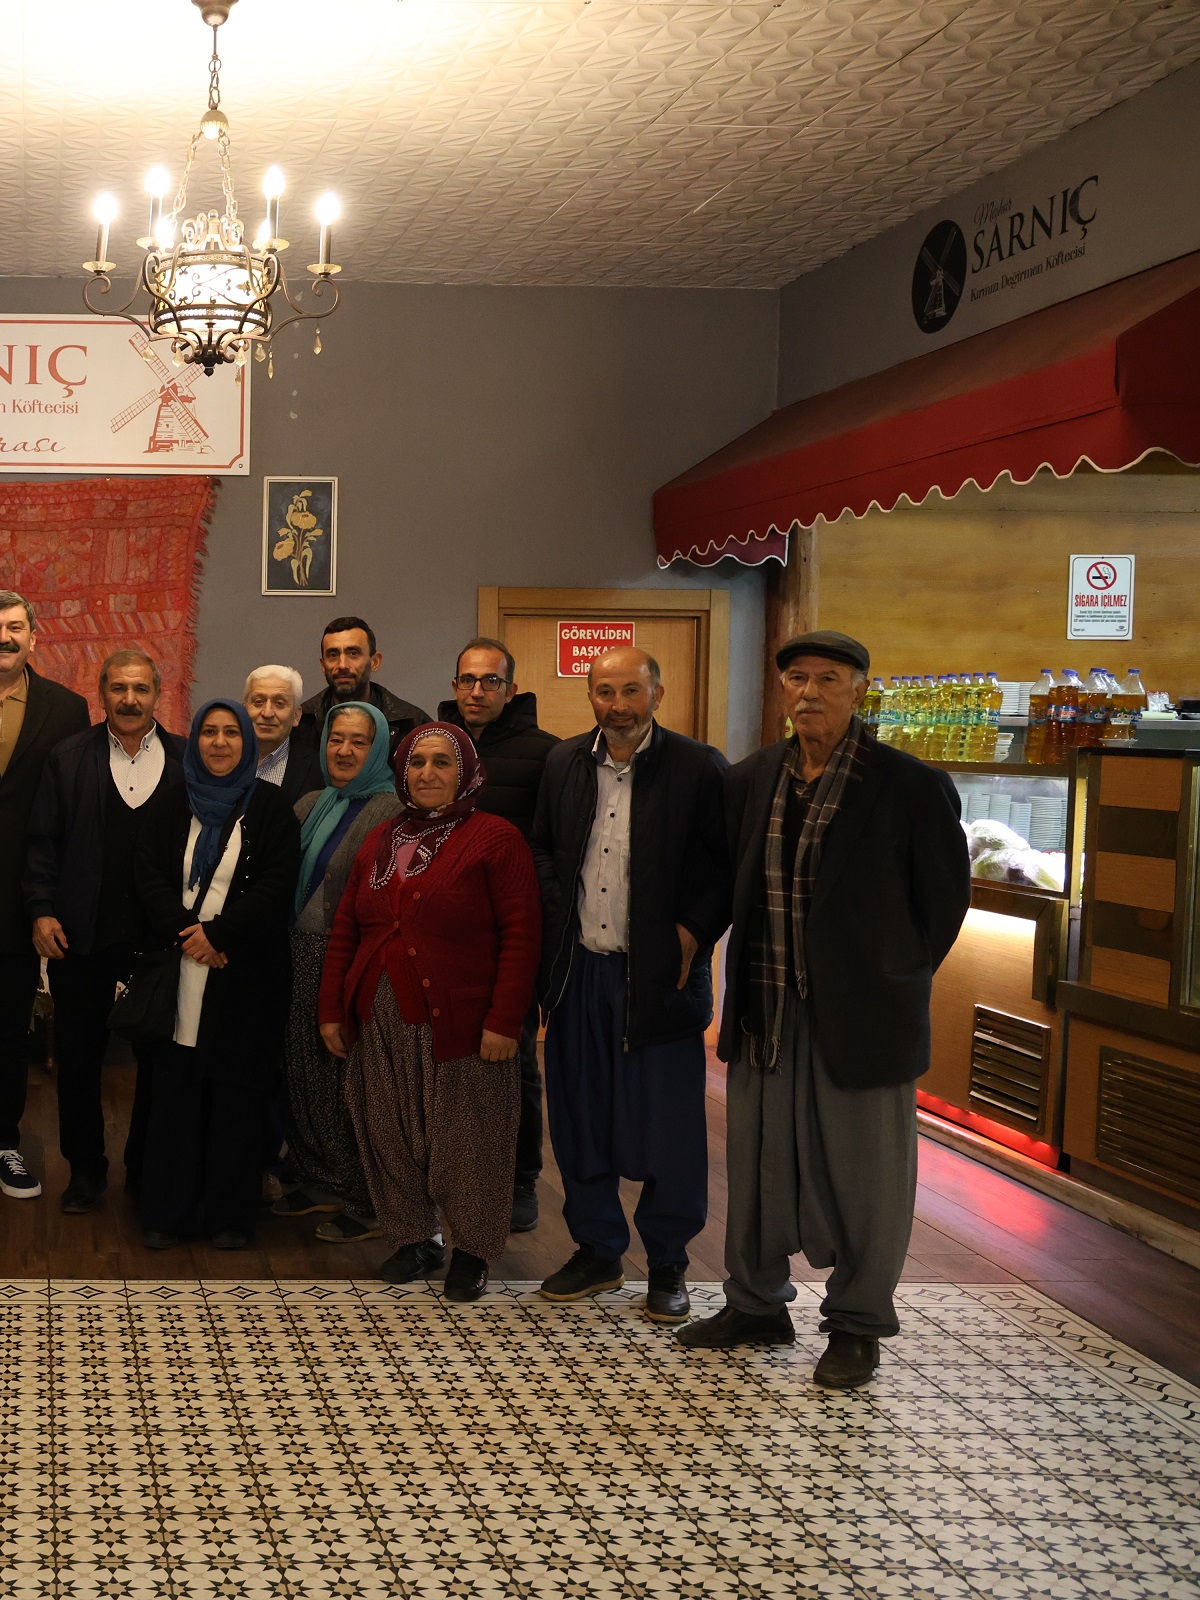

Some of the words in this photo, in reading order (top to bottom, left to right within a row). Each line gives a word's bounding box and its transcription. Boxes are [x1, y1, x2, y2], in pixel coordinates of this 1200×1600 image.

[971, 175, 1098, 274] SARNIÇ
[970, 282, 999, 302] Kırmızı
[1001, 263, 1043, 289] Değirmen
[1046, 243, 1086, 271] Köftecisi
[12, 398, 79, 415] Köftecisi
[1074, 592, 1099, 607] SİGARA
[1101, 592, 1128, 609] İÇİLMEZ
[561, 626, 631, 640] GÖREVLİDEN
[572, 646, 616, 659] BAŞKA
